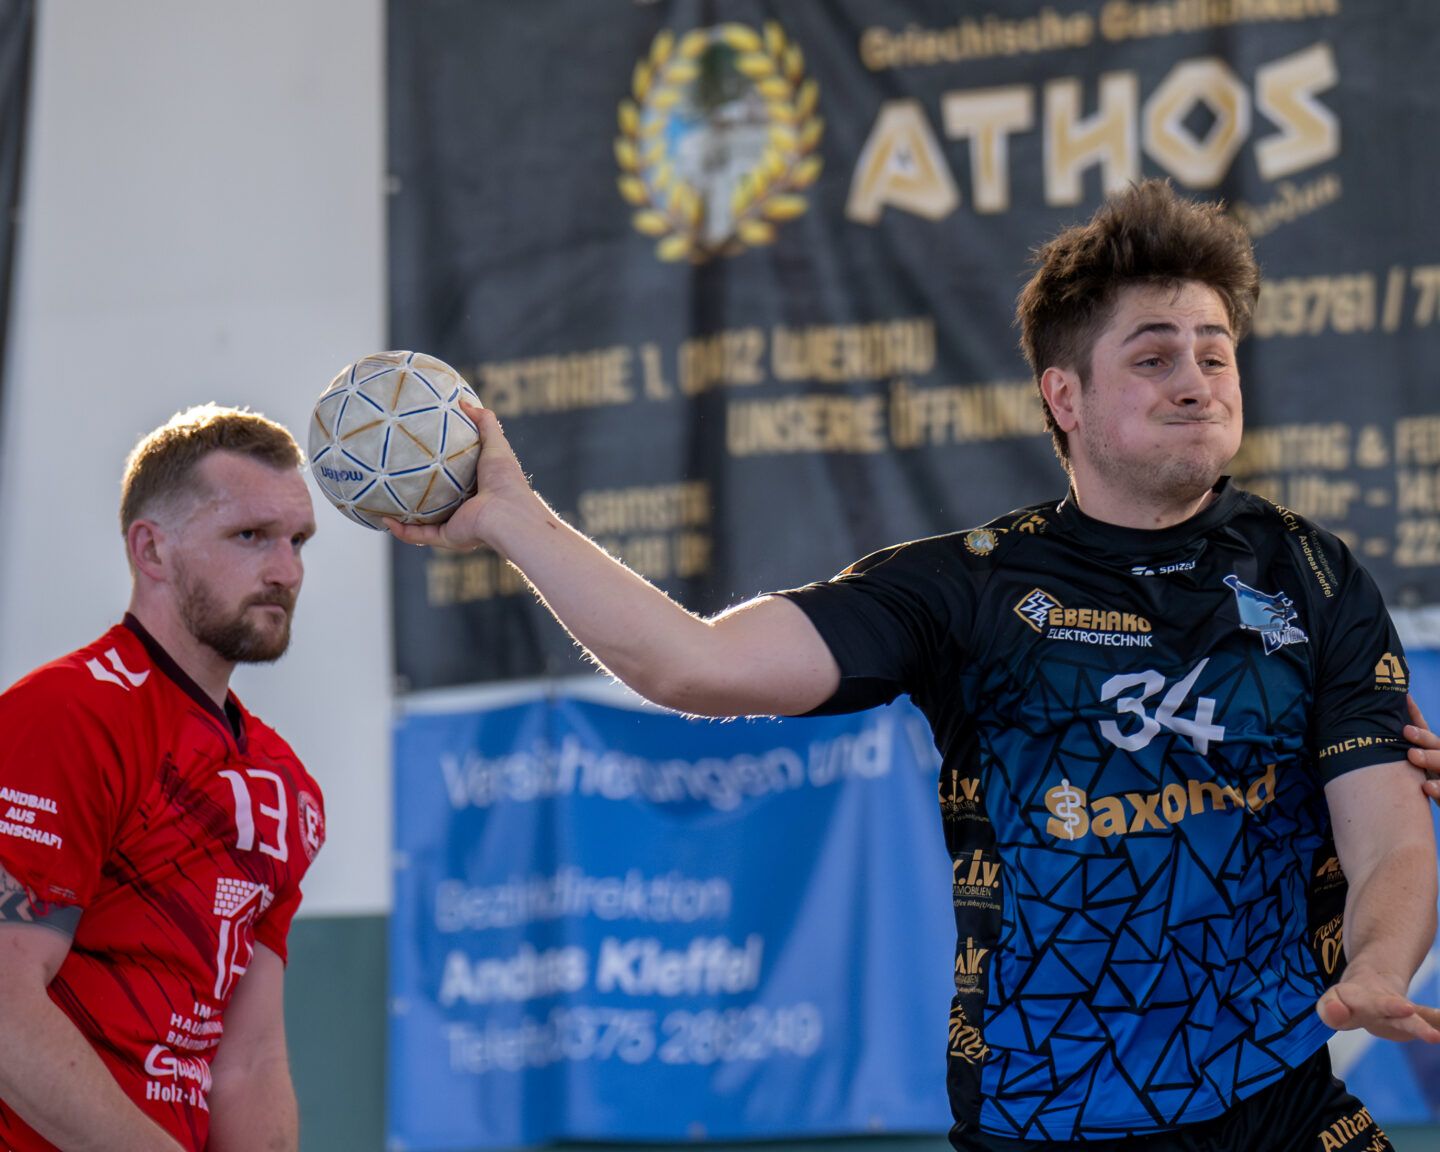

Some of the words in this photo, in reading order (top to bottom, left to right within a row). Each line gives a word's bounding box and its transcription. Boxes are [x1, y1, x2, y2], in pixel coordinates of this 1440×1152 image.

[845, 43, 1340, 226] ATHOS
[1047, 628, 1153, 648] ELEKTROTECHNIK
[1049, 607, 1152, 633] EBEHAKO
[1098, 657, 1226, 756] 34
[5, 806, 36, 824] AUS
[217, 768, 289, 864] 13
[1044, 763, 1277, 842] Saxomd
